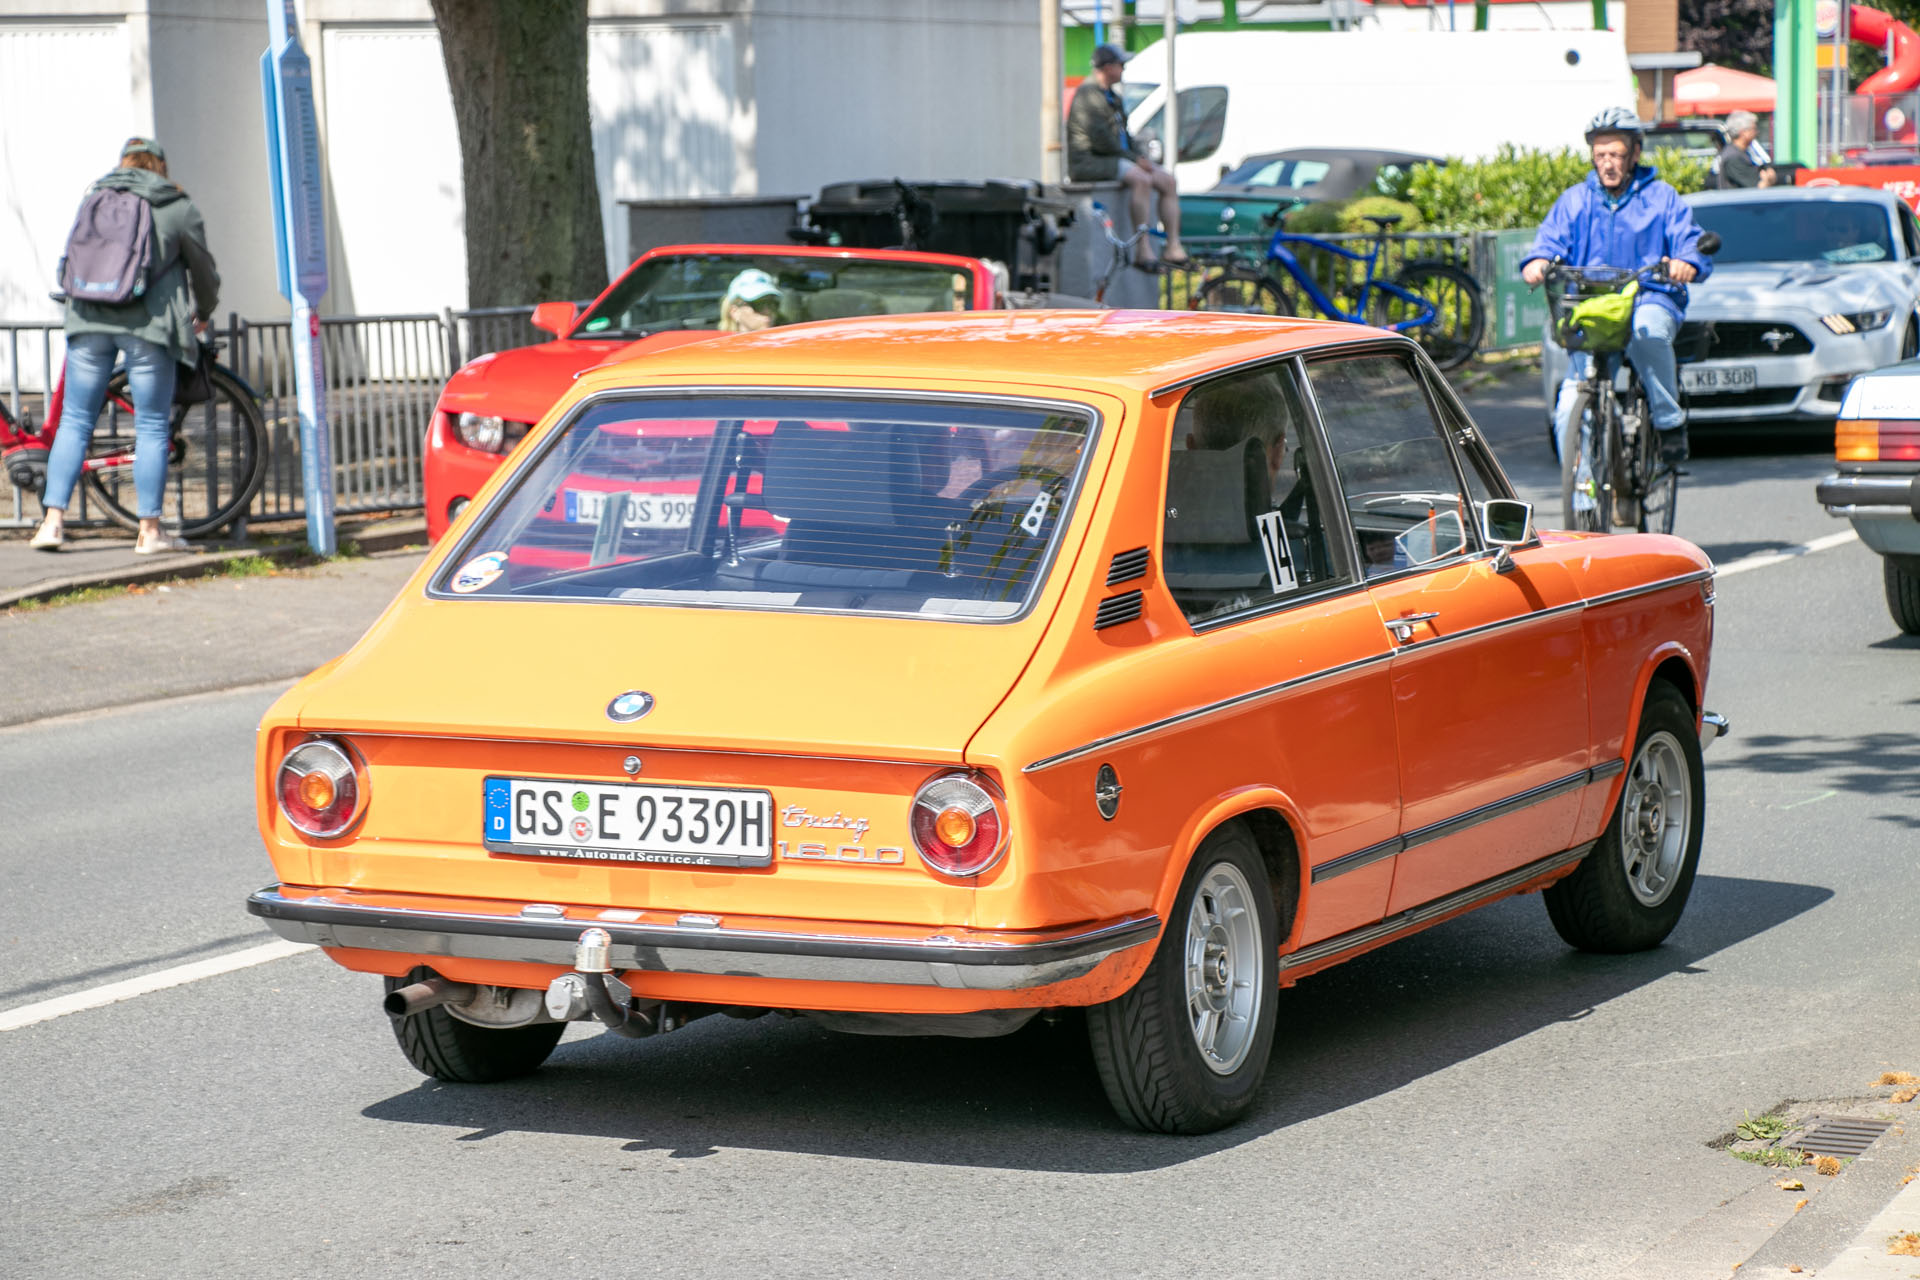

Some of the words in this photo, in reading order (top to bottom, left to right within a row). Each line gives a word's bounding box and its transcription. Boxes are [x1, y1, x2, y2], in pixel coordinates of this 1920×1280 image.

[578, 496, 607, 520] LI
[1261, 514, 1295, 586] 14
[493, 816, 505, 830] D
[515, 788, 563, 836] GS
[599, 793, 621, 840] E
[636, 794, 763, 847] 9339H
[777, 840, 904, 864] 1600
